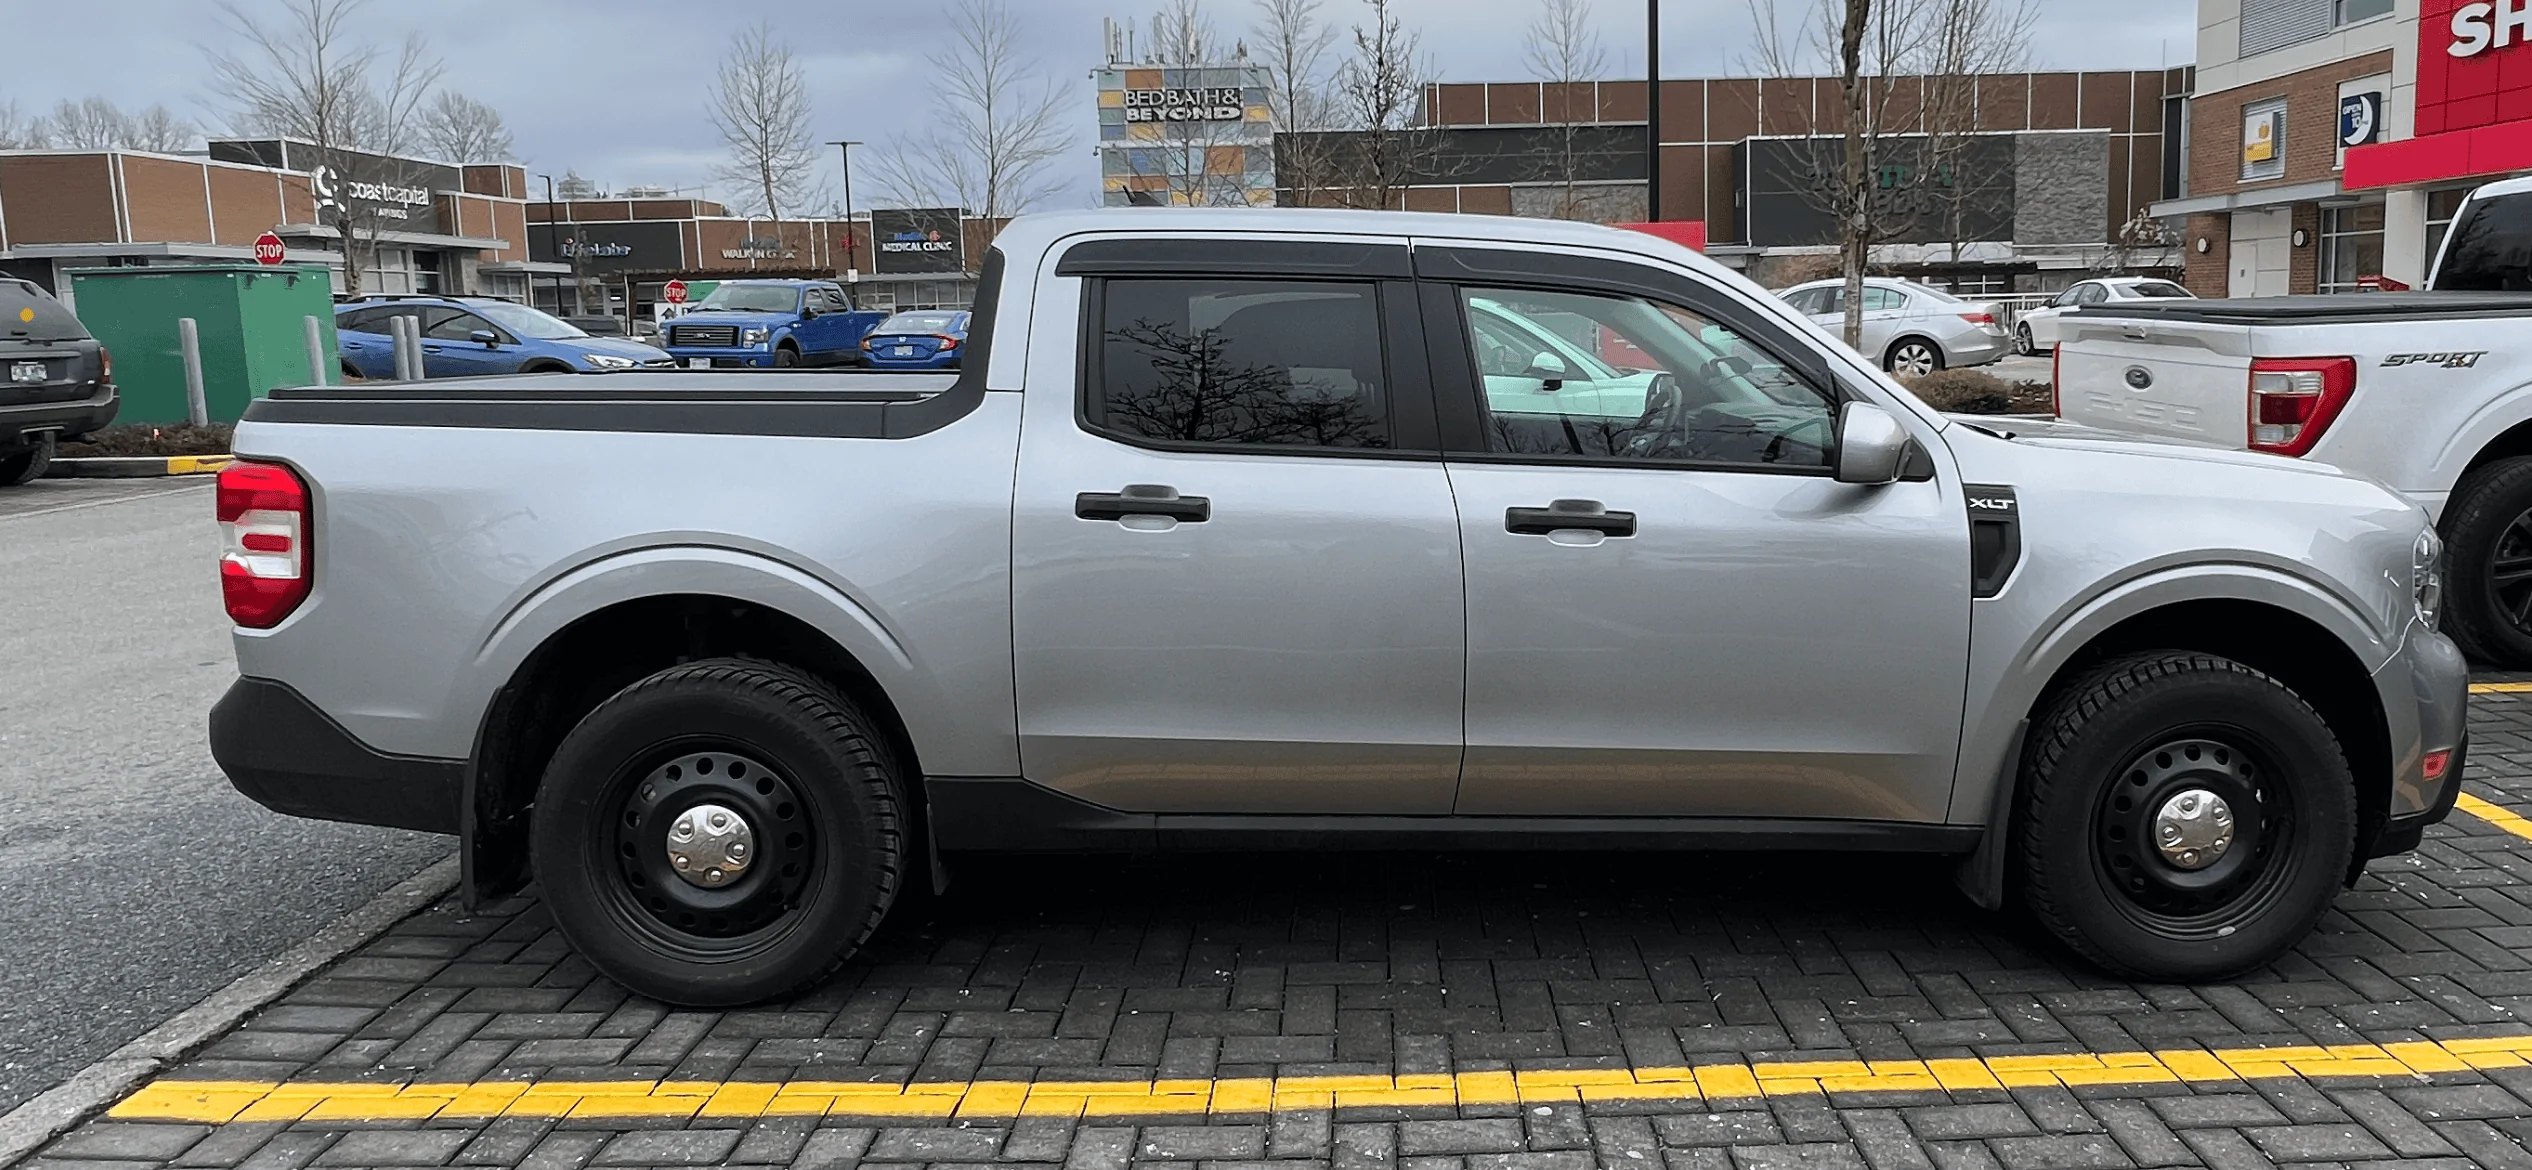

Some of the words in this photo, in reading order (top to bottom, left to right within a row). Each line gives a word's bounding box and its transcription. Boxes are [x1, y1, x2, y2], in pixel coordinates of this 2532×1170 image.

[2447, 0, 2532, 57] SH
[1126, 90, 1165, 106] BED
[1167, 89, 1219, 104] BATH
[1222, 89, 1239, 104] &
[1126, 107, 1240, 120] BEYOND
[257, 244, 282, 258] STOP
[882, 242, 922, 252] MEDICAL
[666, 287, 686, 297] STOP
[2380, 351, 2489, 368] SPORT
[1970, 498, 2015, 510] XLT
